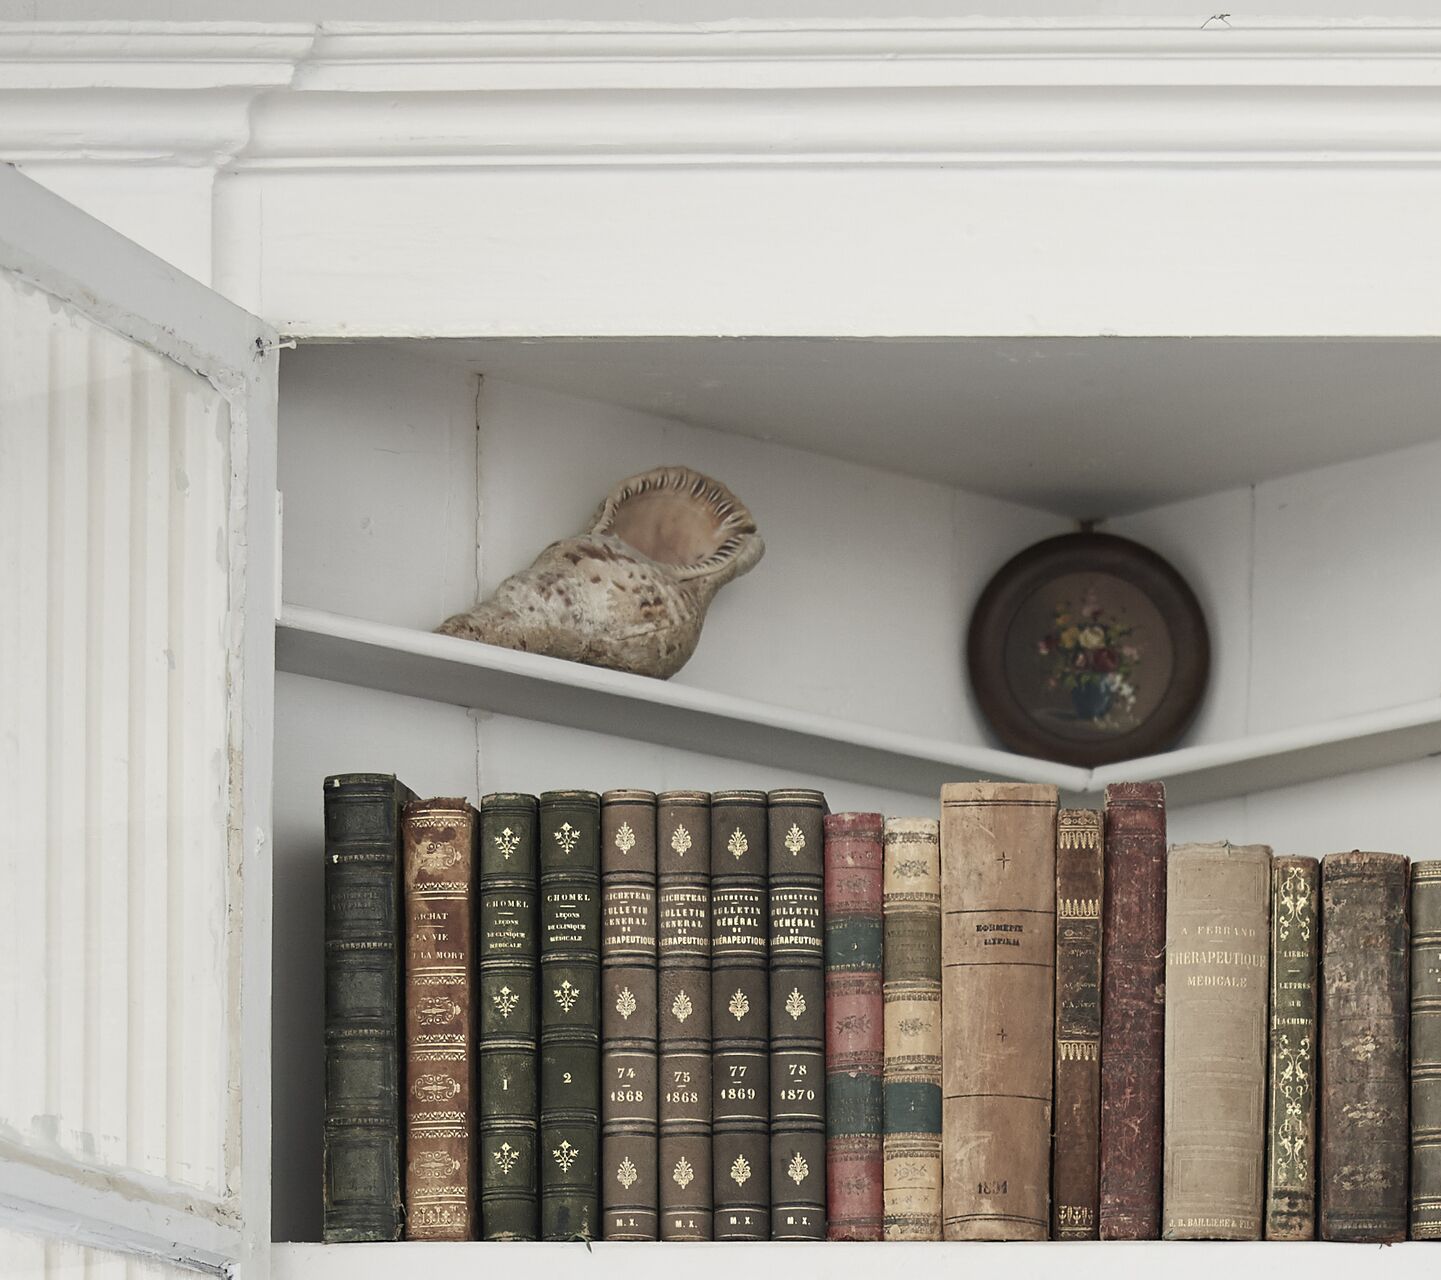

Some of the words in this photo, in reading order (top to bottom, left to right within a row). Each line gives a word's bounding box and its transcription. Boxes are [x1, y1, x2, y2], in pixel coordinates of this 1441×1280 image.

[547, 893, 591, 902] CHOMEL
[486, 900, 528, 908] CHOMEL
[717, 916, 758, 927] GÉNÉRAL
[774, 917, 816, 928] GÉNÉRAL
[432, 932, 449, 941] VIE
[1197, 926, 1256, 937] FERRAND
[420, 952, 432, 960] LA
[435, 951, 465, 961] MORT
[617, 1067, 636, 1079] 74
[729, 1066, 748, 1077] 77
[789, 1064, 808, 1076] 78
[563, 1071, 572, 1084] 2
[674, 1071, 691, 1083] 75
[502, 1078, 509, 1091] 1
[610, 1090, 644, 1102] 1868
[666, 1092, 699, 1103] 1868
[720, 1088, 757, 1100] 1869
[780, 1089, 815, 1100] 1870
